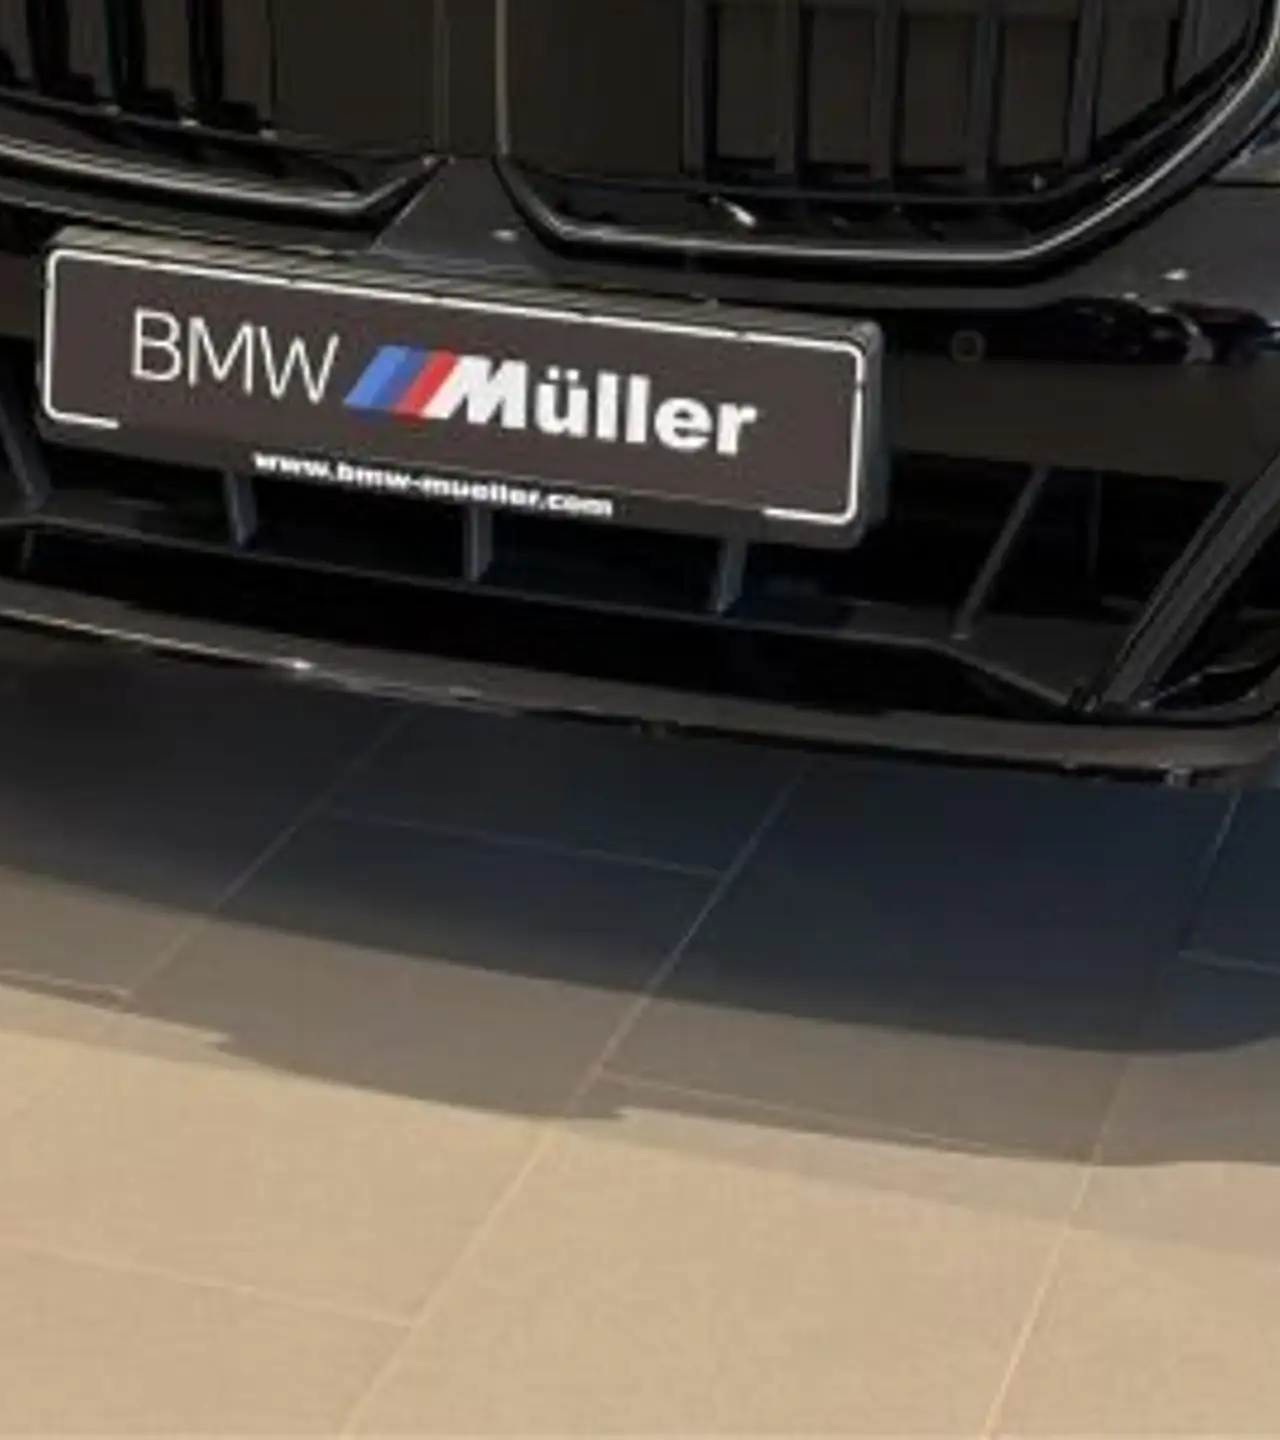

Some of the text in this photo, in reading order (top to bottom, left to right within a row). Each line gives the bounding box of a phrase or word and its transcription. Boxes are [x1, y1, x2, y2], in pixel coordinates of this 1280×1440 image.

[130, 307, 759, 456] BMW Müller
[251, 451, 614, 517] www.bmw-mueller.com
